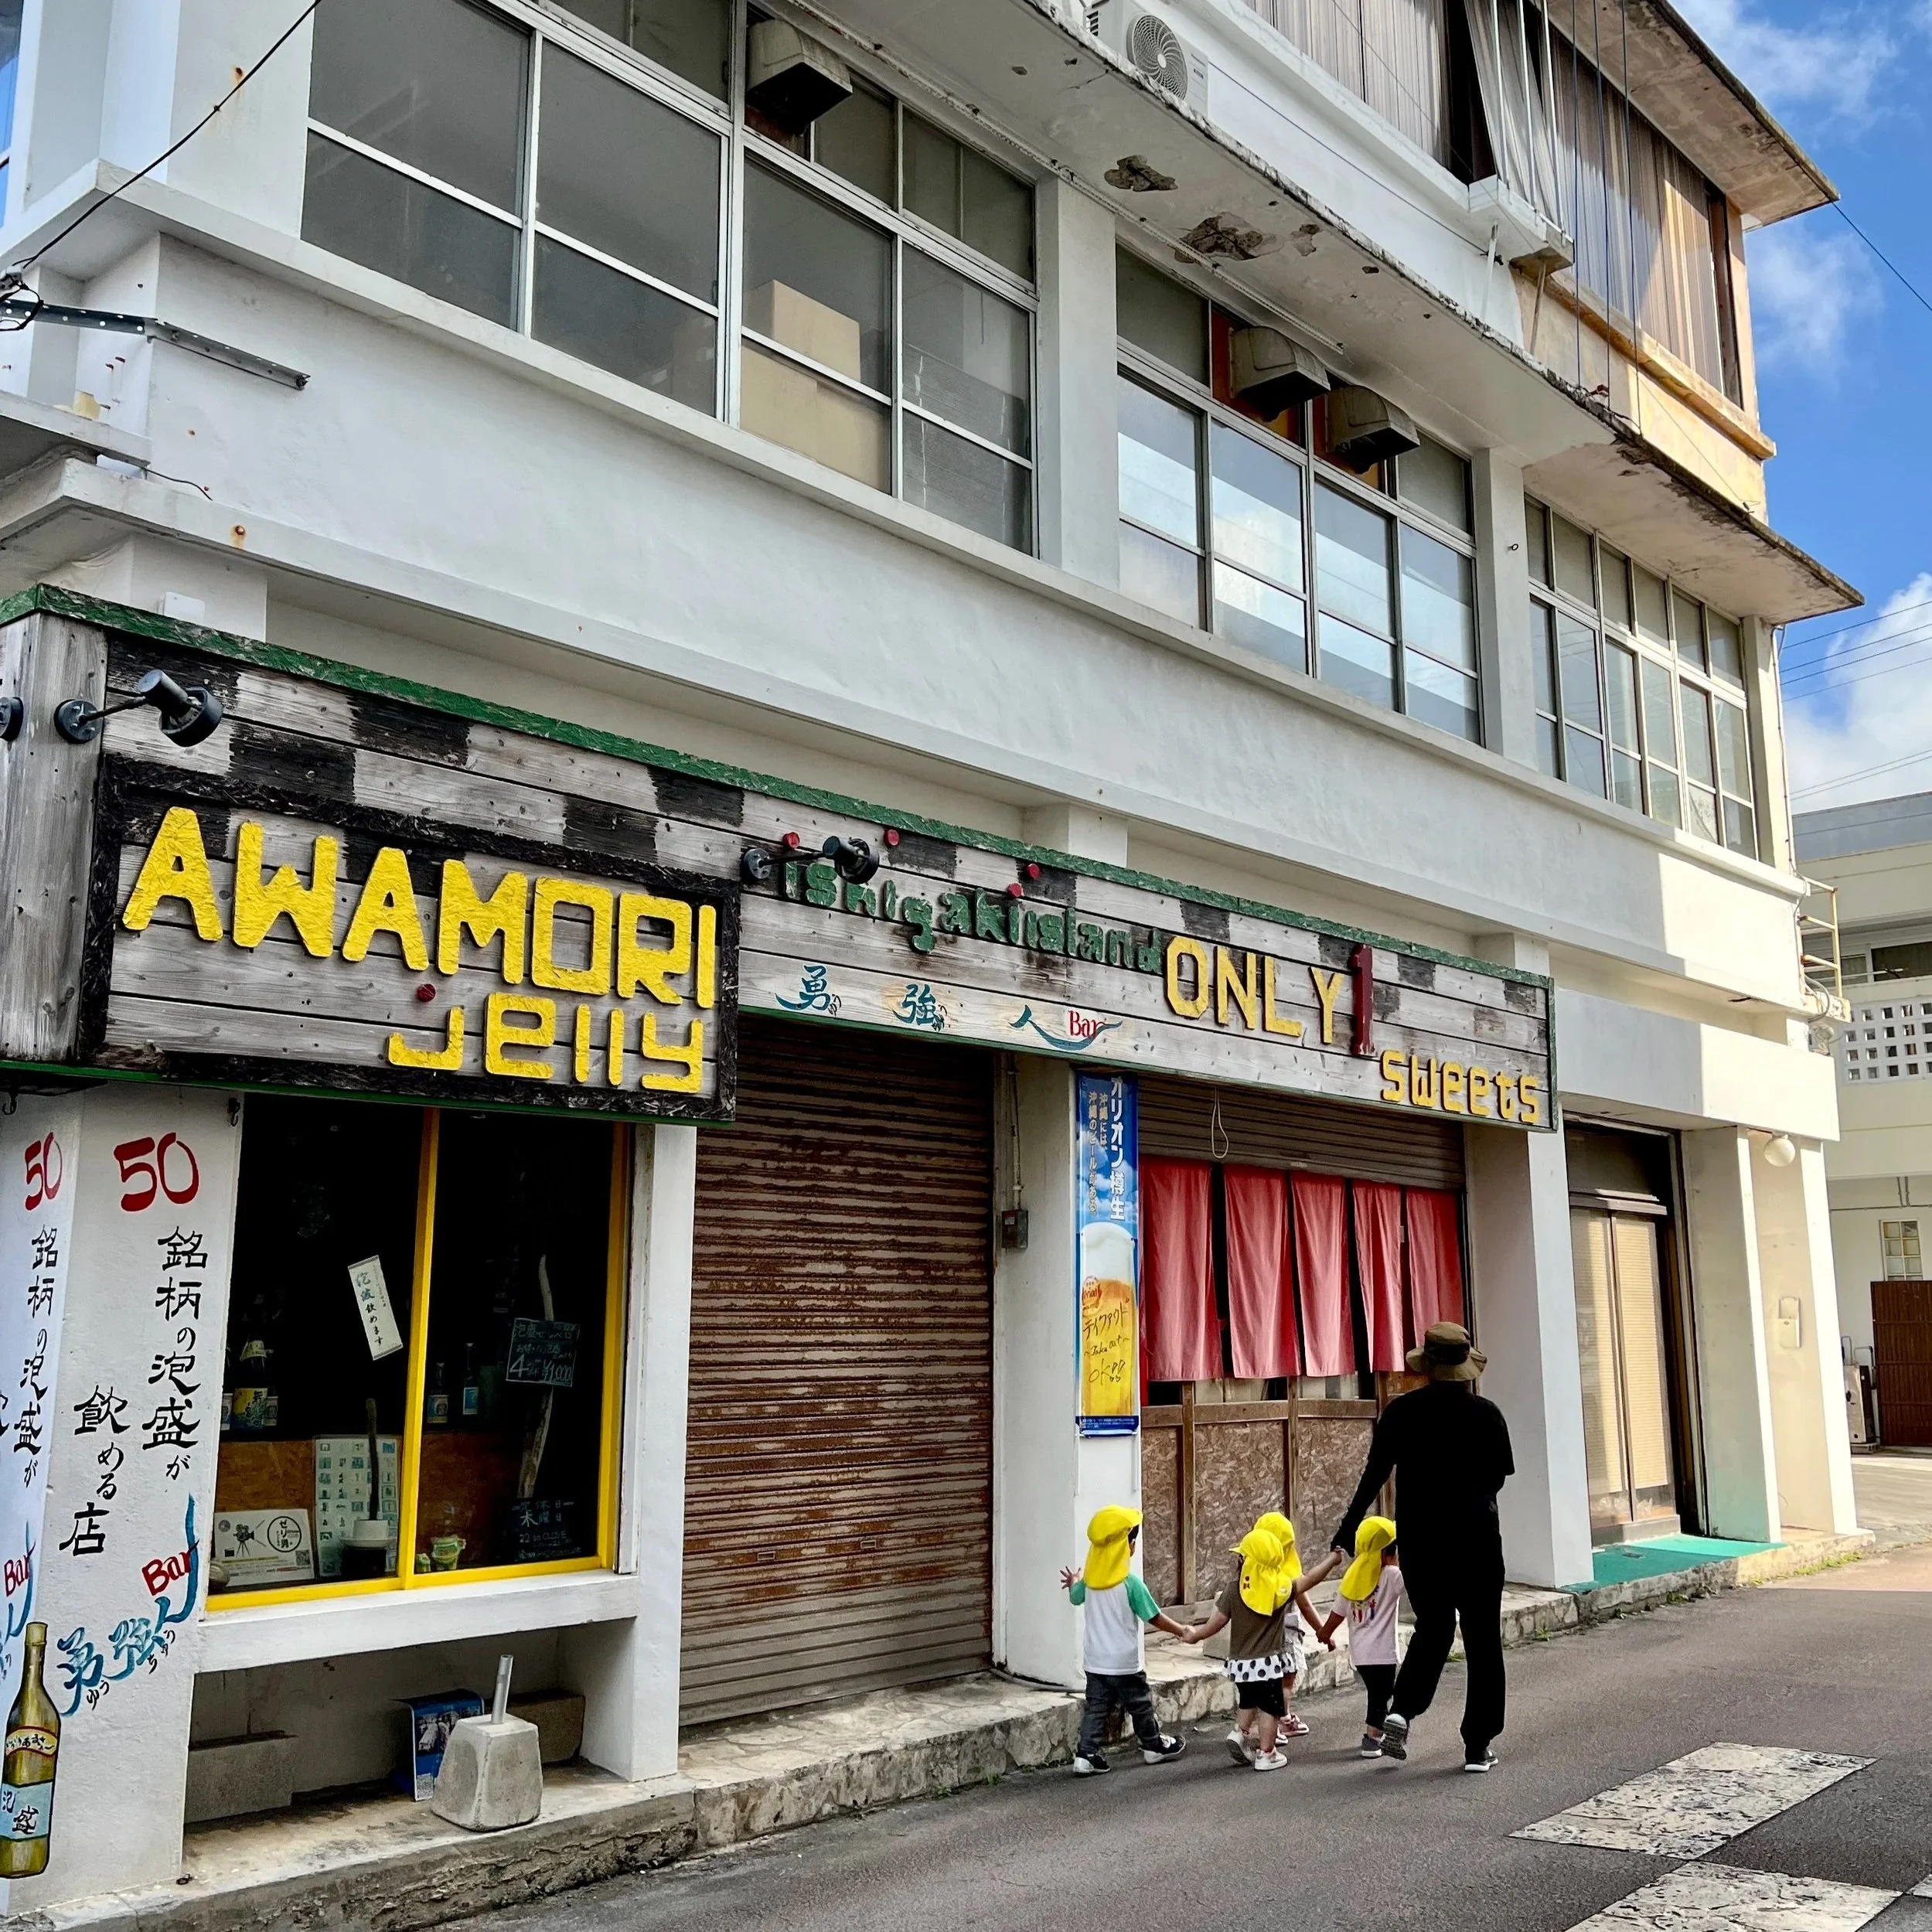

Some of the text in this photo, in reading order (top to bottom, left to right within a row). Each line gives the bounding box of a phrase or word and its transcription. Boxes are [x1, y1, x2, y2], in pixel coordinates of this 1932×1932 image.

[122, 806, 717, 1009] AWAMORI
[1068, 1010, 1106, 1039] Bar
[1166, 935, 1344, 1044] ONLY
[14, 1132, 62, 1488] 50 銘柄の泡盛が
[114, 1132, 208, 1480] 50 銘柄の泡盛が
[59, 1384, 131, 1557] 飲める店
[4, 1540, 36, 1597] Bar
[142, 1539, 200, 1596] Bar
